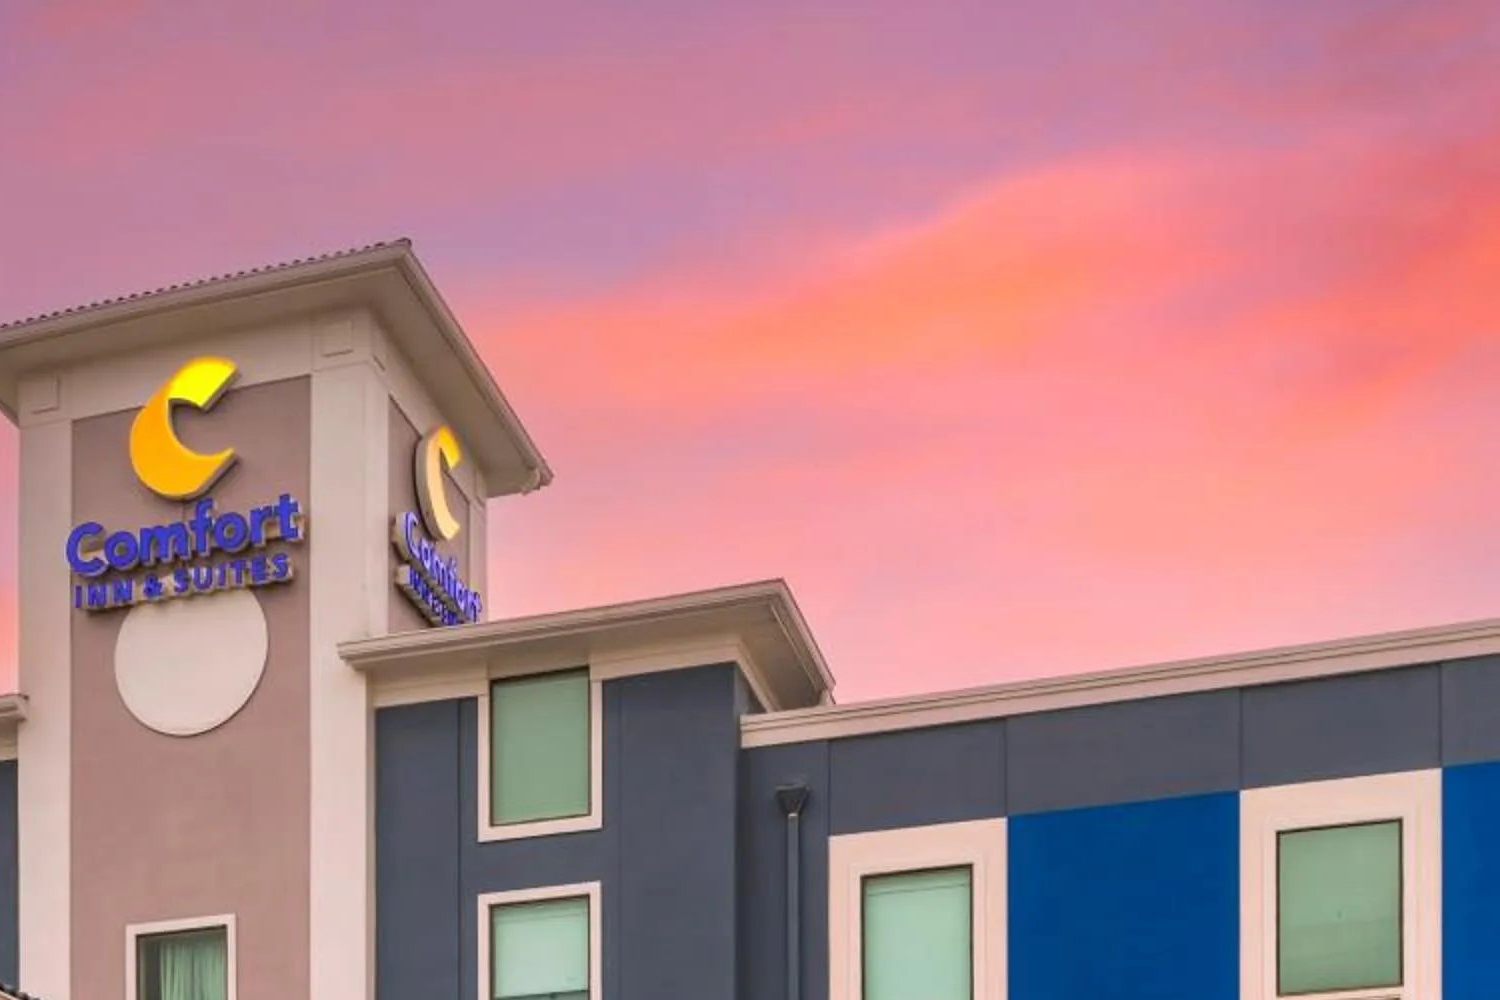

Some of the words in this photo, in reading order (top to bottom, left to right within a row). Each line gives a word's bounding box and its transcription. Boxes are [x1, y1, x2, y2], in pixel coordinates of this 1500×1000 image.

[65, 494, 300, 577] Comfort
[75, 578, 133, 608] INN
[143, 573, 163, 598] &
[174, 552, 291, 594] SUITES
